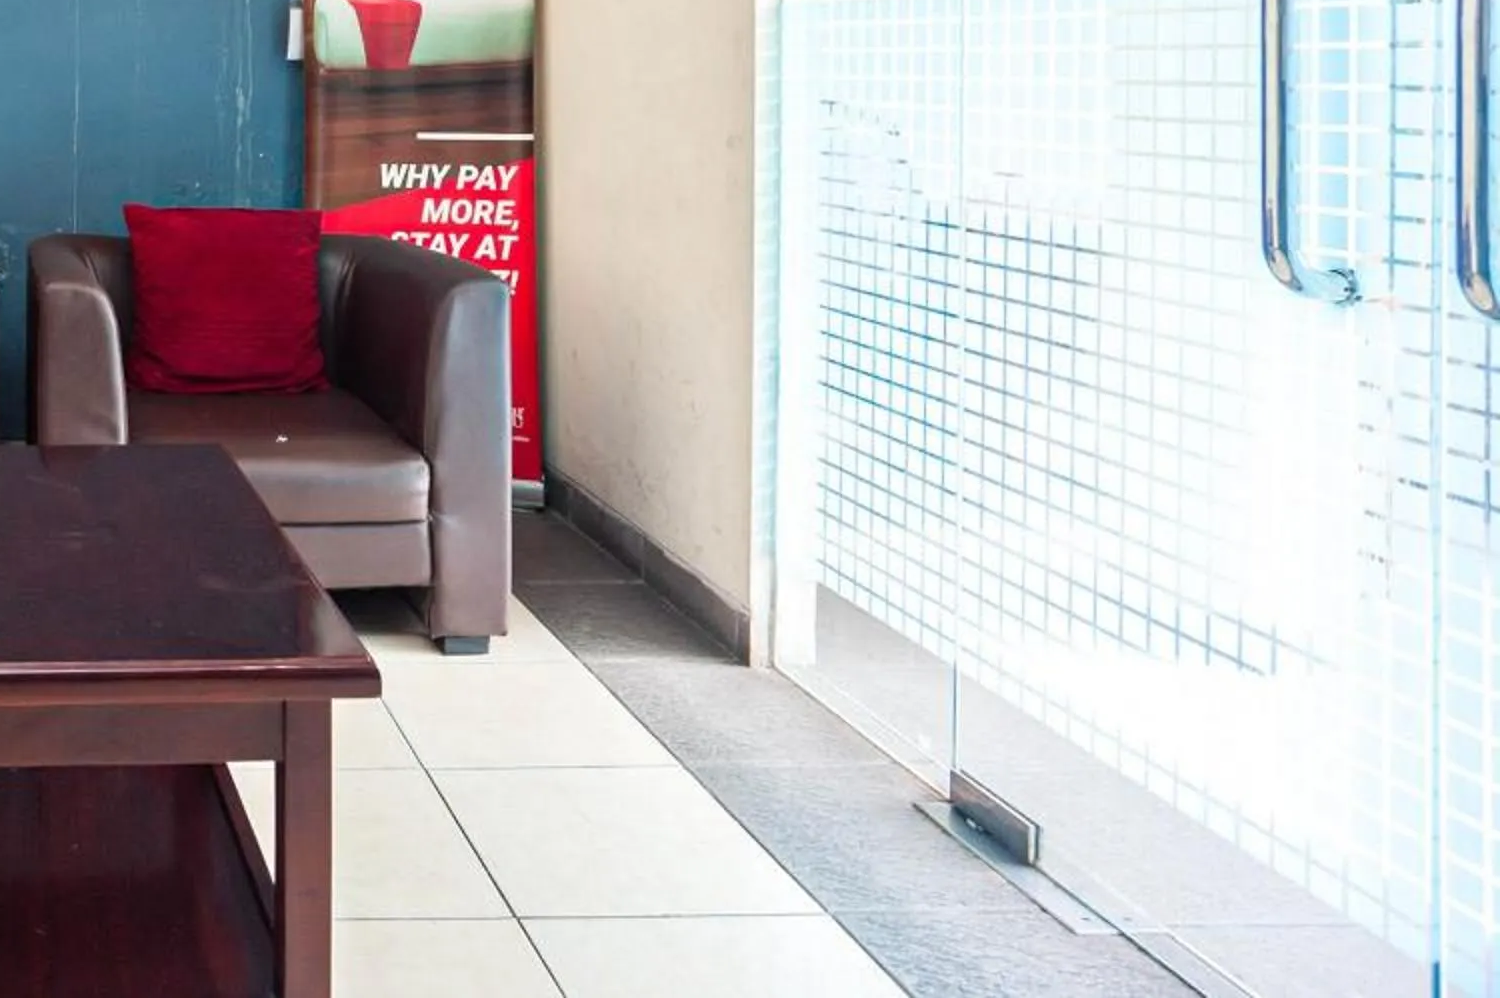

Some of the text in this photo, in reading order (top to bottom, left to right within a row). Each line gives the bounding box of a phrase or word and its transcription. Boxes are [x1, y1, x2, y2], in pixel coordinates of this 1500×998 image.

[381, 163, 519, 190] WHY PAY
[420, 198, 520, 232] MORE,
[473, 233, 519, 261] AT
